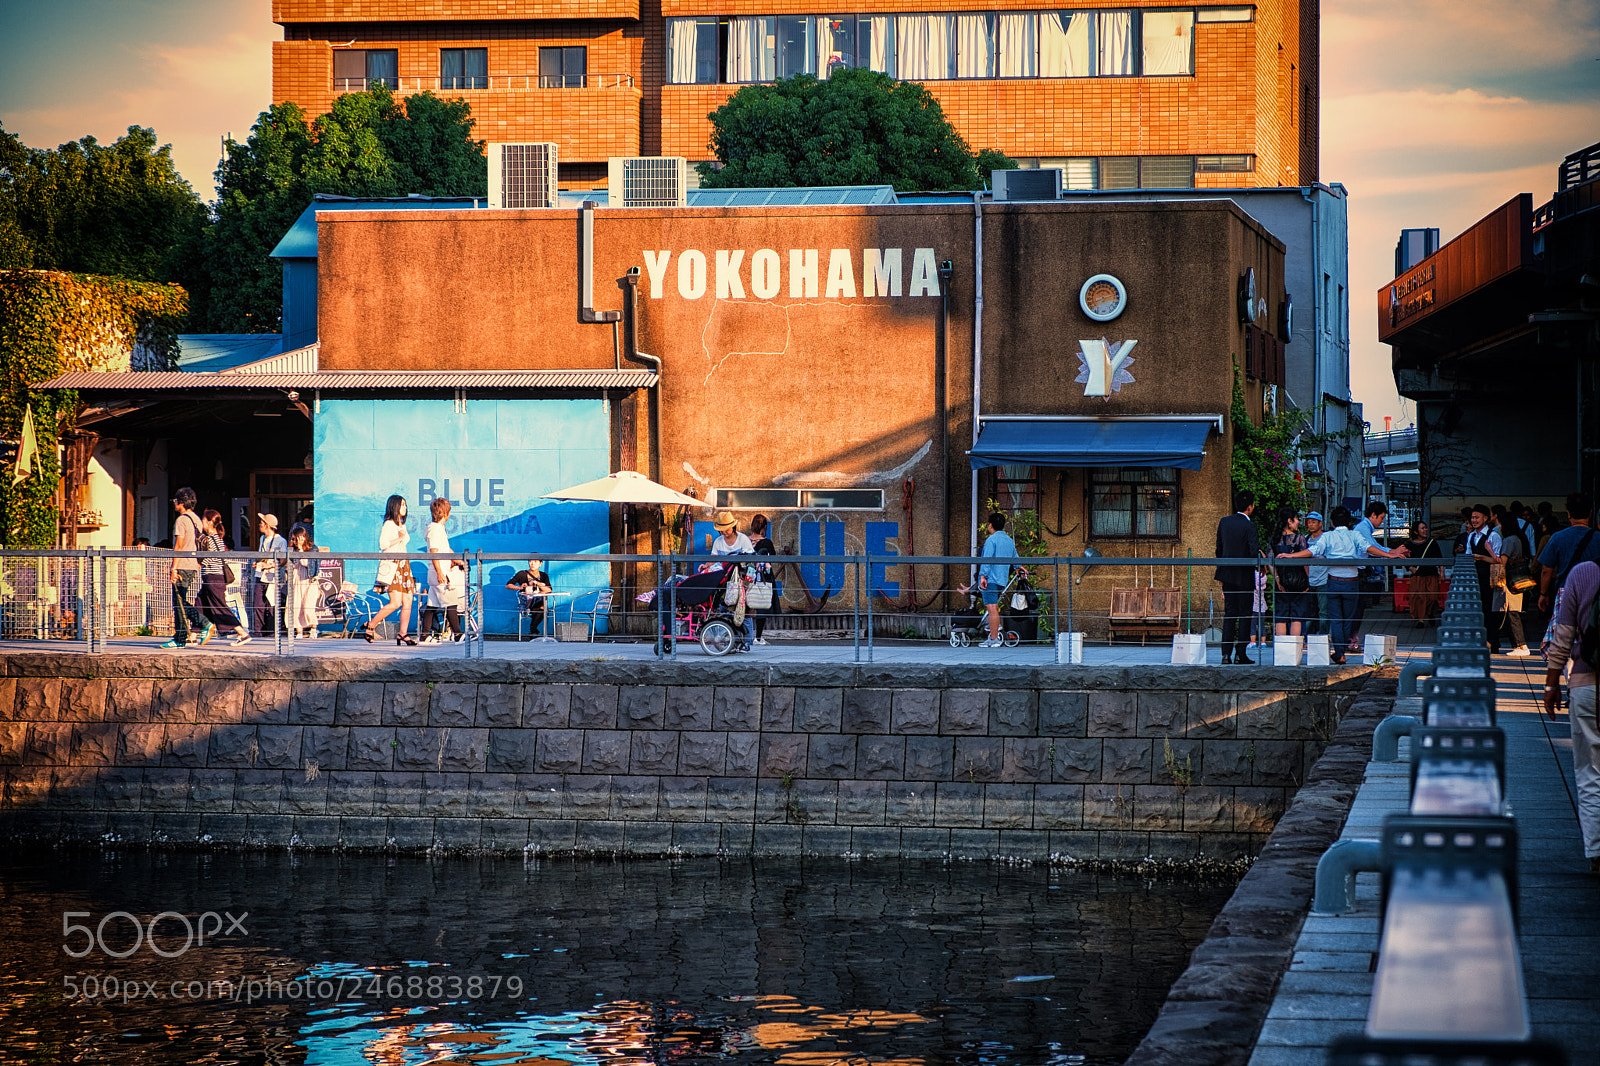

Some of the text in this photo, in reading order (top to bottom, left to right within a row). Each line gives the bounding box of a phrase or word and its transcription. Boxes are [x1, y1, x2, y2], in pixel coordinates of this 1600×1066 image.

[643, 247, 941, 300] YOKOHAMA
[418, 478, 505, 507] BLUE
[379, 514, 544, 535] OKOHAMA
[688, 521, 900, 598] BUE
